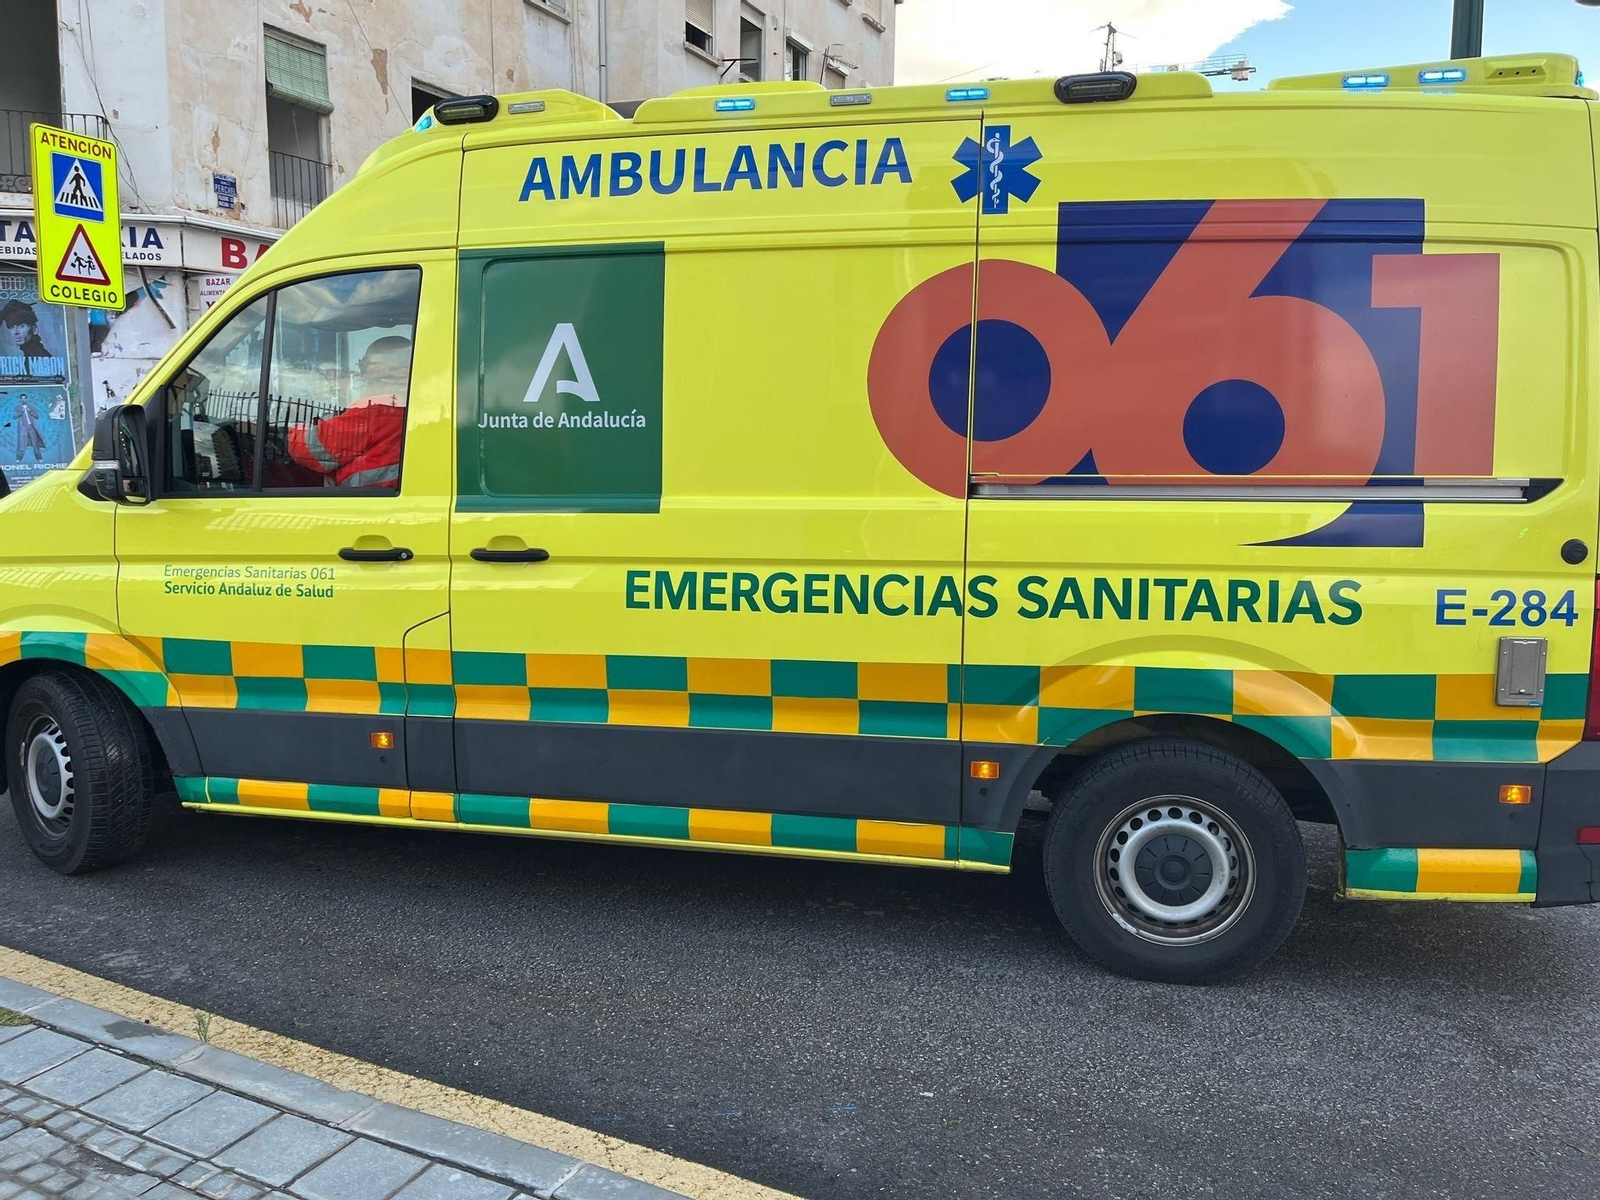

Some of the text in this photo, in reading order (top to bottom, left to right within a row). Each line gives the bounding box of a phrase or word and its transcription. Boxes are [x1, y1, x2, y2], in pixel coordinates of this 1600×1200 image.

[41, 132, 111, 159] ATENCIÓN
[518, 137, 912, 202] AMBULANCIA
[206, 278, 231, 286] BAZAR
[51, 285, 117, 303] COLEGIO
[867, 199, 1500, 499] 061
[28, 356, 65, 376] MASON
[478, 409, 646, 428] Junta de Andalucía
[34, 462, 67, 470] RICHIE
[164, 565, 335, 580] Emergencias Sanitarias 061
[164, 581, 334, 598] Servicio Andaluz de Salud
[625, 570, 1363, 626] EMERGENCIAS SANITARIAS
[1436, 589, 1579, 627] E-284
